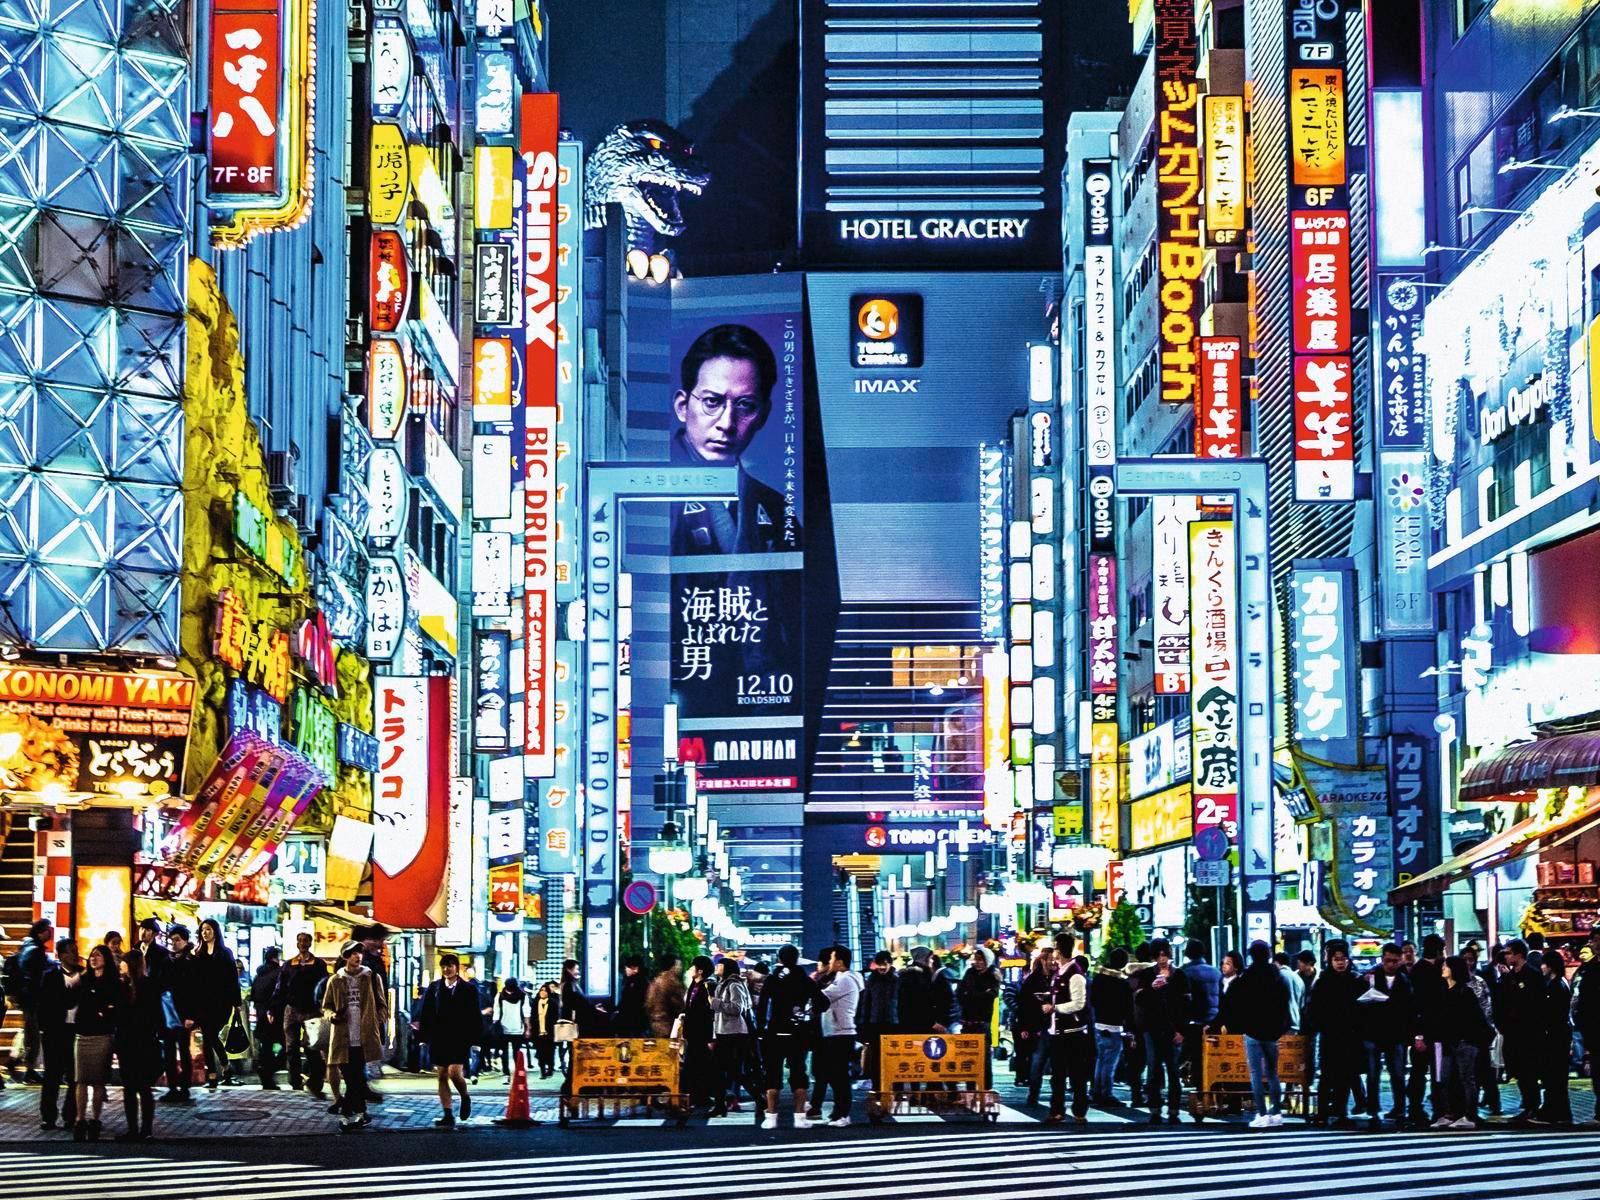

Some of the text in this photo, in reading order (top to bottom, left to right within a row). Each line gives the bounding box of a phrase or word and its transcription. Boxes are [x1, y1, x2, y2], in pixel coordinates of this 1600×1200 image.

[1303, 46, 1330, 58] 7F
[379, 104, 394, 114] 5F
[1305, 188, 1335, 206] 6F
[841, 218, 1030, 239] HOTEL GRACERY
[1215, 230, 1237, 243] 6F
[525, 151, 558, 349] SHIDAX
[1159, 242, 1202, 400] Booth
[855, 379, 919, 393] IMAX
[1481, 406, 1505, 446] Don
[525, 427, 548, 578] BIC DRUG
[681, 586, 768, 622] 海賊と
[1395, 592, 1421, 608] 5F
[680, 622, 761, 644] よばれた
[373, 640, 391, 651] B1
[1301, 575, 1341, 732] カラオケ
[680, 646, 713, 681] 男
[124, 677, 194, 706] YAKI
[591, 530, 611, 843] GODZILLA ROAD
[736, 674, 794, 696] 12.10
[1162, 673, 1191, 693] B1
[737, 695, 793, 705] ROADSHOW
[381, 688, 405, 799] トラノコ
[1197, 686, 1238, 789] 金の蔵
[713, 739, 796, 761] MARUHAN
[1197, 800, 1229, 824] 2F
[1396, 742, 1424, 865] カラオケ
[1351, 815, 1380, 917] カラオケ
